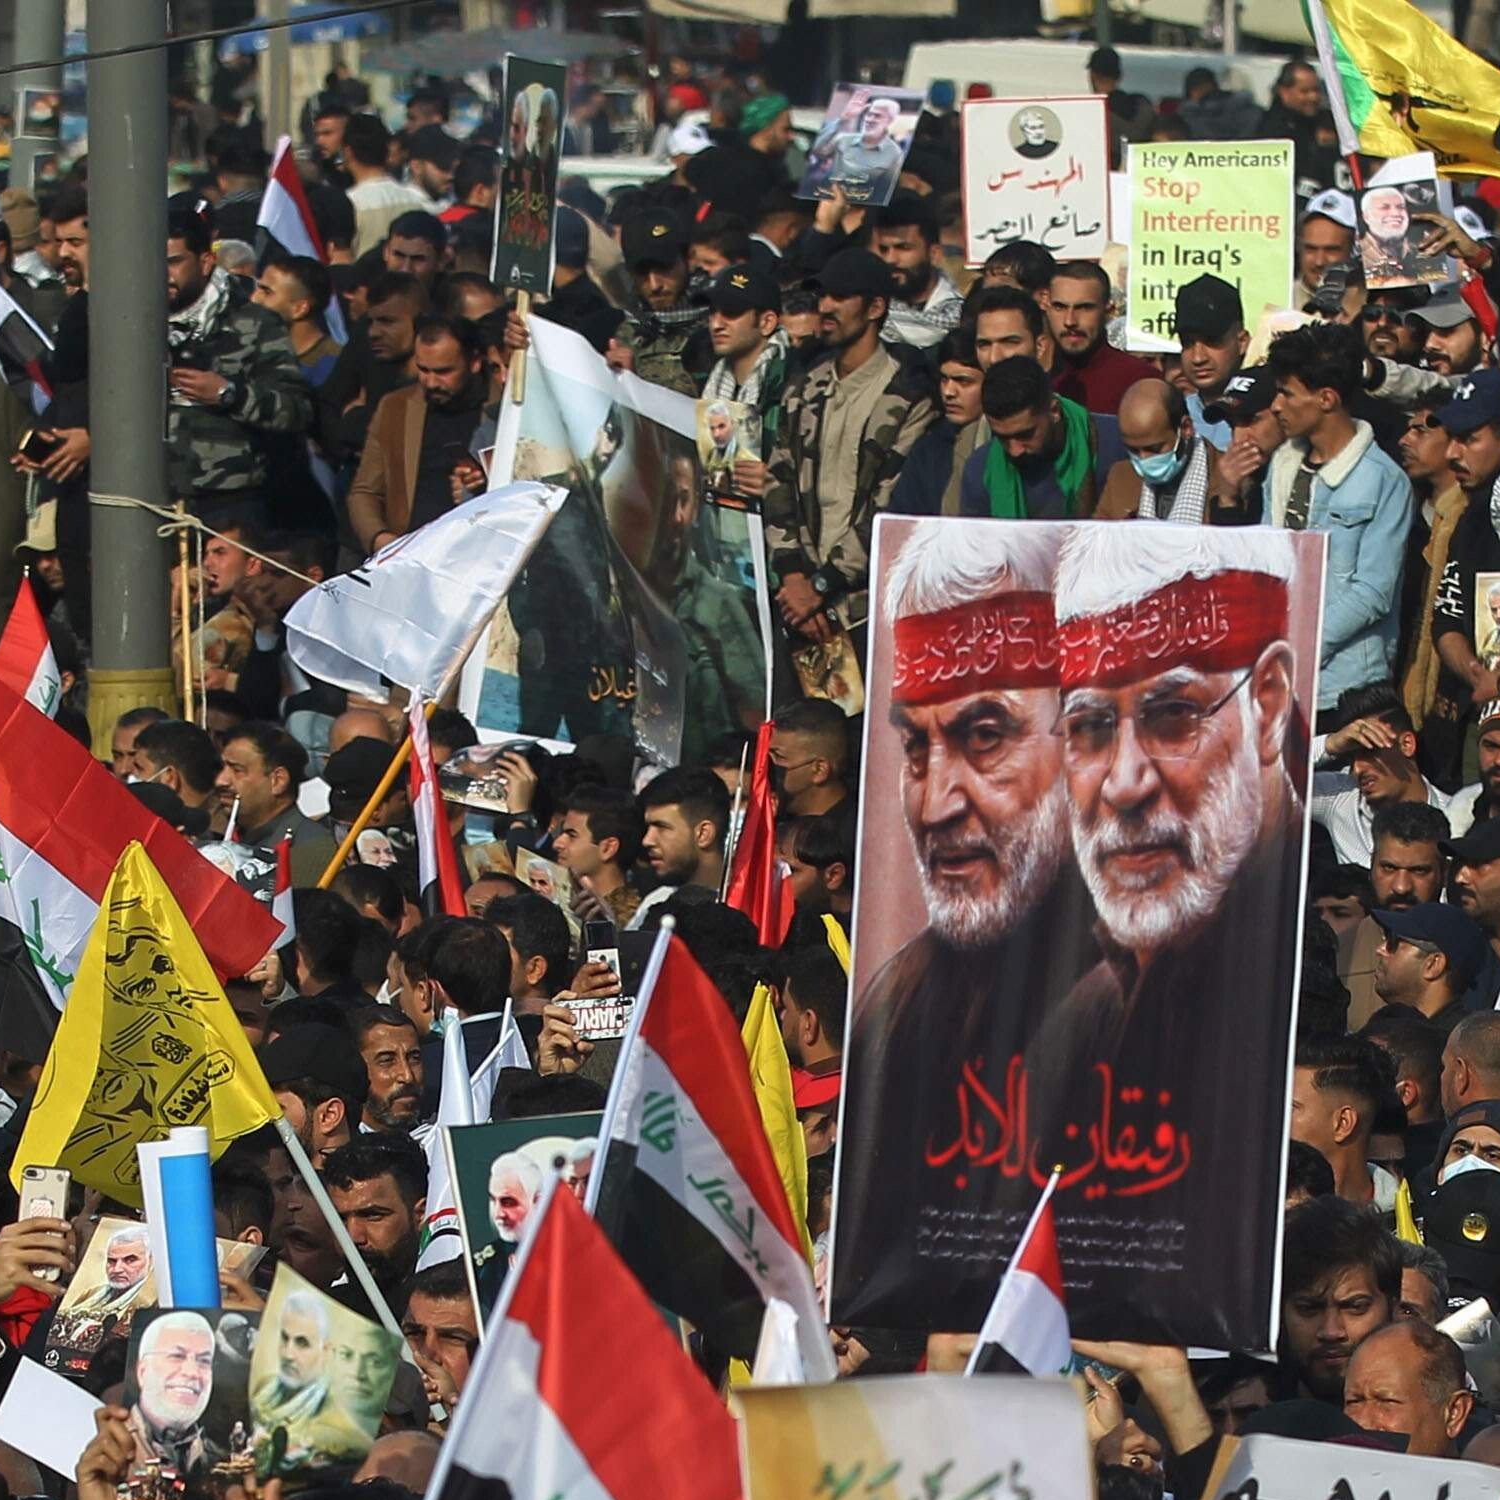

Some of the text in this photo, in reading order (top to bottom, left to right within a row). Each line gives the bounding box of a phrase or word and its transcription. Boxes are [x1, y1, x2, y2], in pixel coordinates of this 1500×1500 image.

[1142, 150, 1288, 172] Hey Americans!
[988, 156, 1083, 198] المهندس
[1143, 177, 1200, 204] Stop
[974, 205, 1101, 250] صانع النصر
[1142, 209, 1281, 239] Interfering
[1142, 244, 1242, 275] in Iraq's
